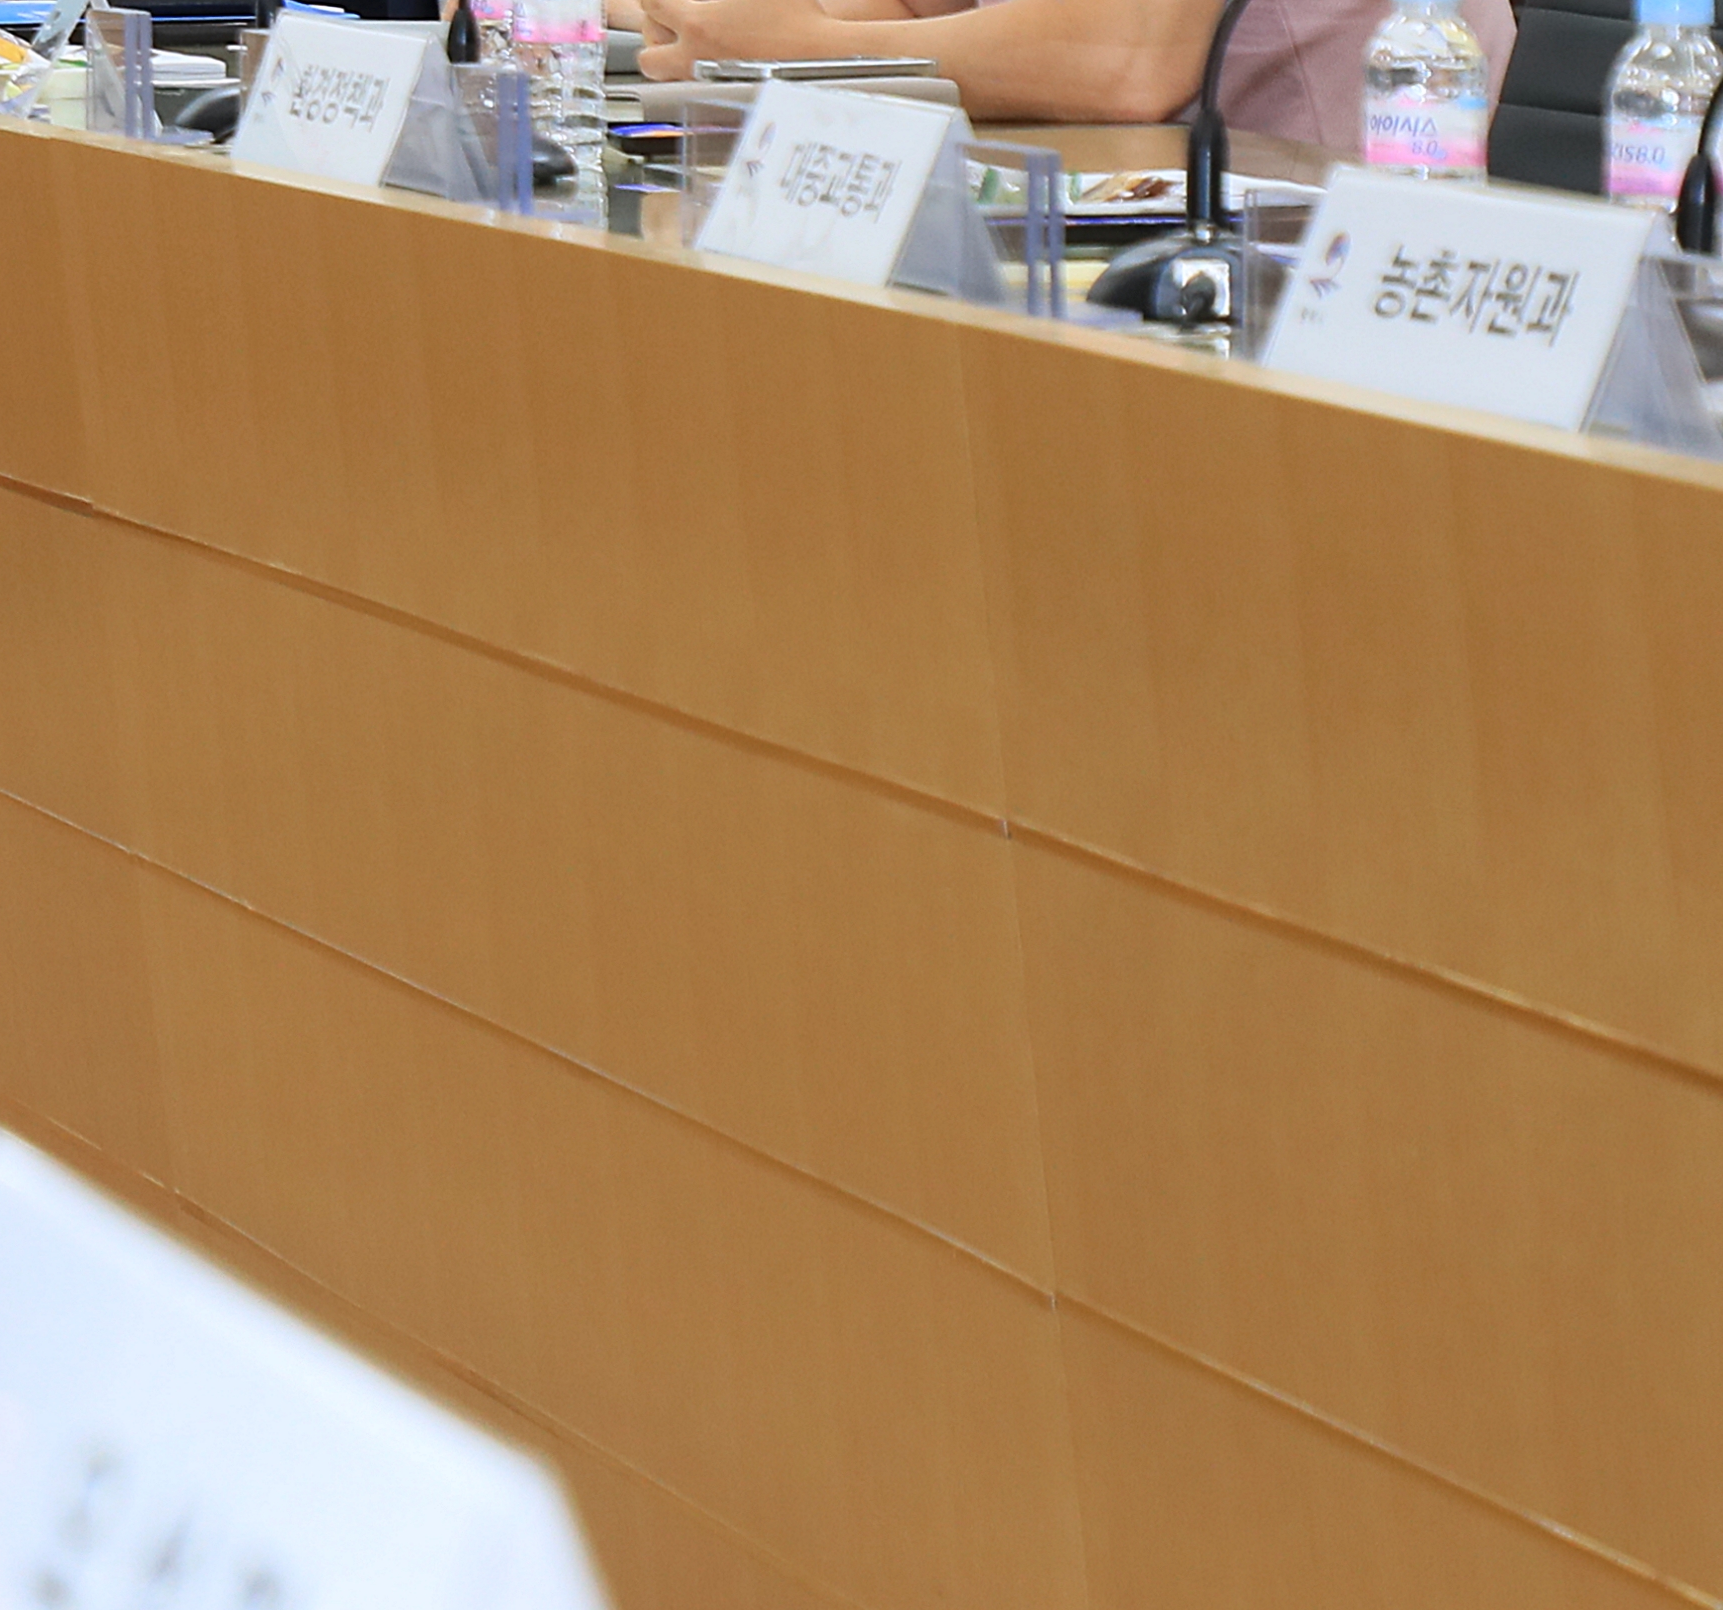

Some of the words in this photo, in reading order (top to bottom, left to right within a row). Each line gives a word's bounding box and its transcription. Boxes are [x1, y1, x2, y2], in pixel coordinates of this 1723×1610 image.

[288, 63, 392, 133] 환경정책과
[1369, 114, 1438, 137] 아이시스
[779, 141, 903, 225] 대중교통과
[1373, 243, 1581, 347] 농촌자원과
